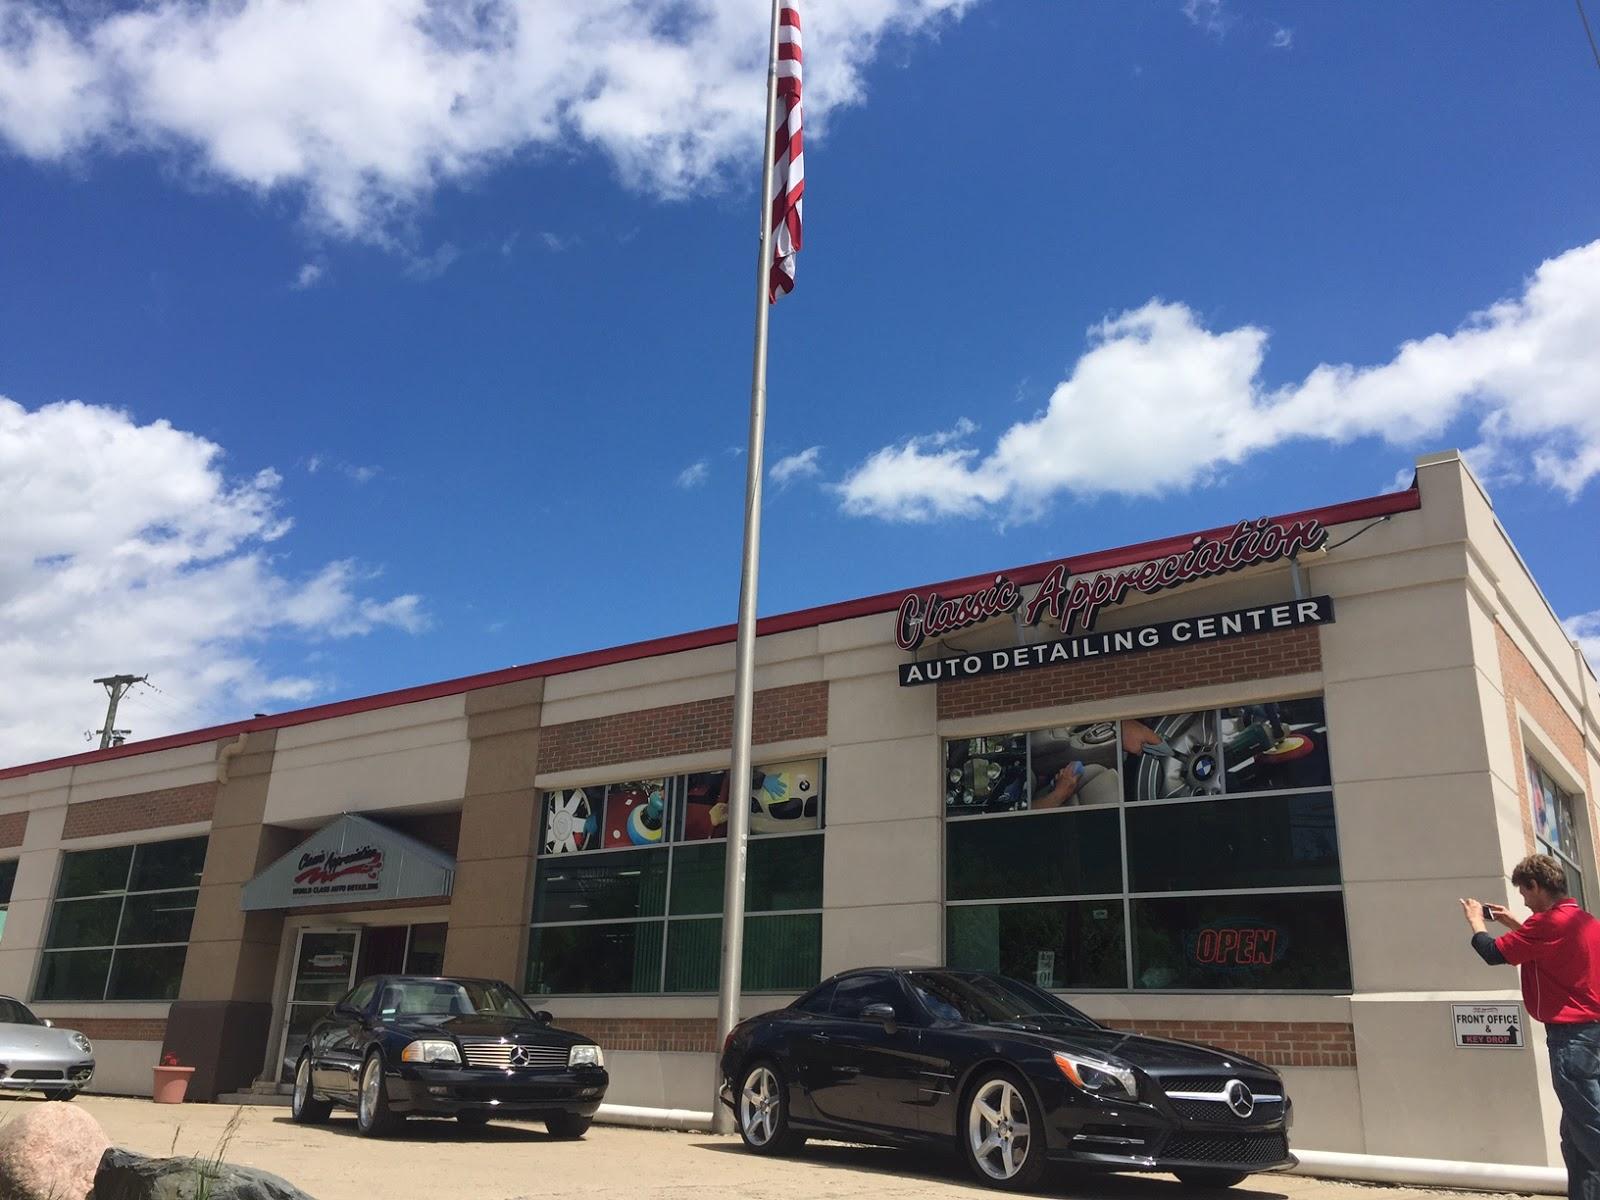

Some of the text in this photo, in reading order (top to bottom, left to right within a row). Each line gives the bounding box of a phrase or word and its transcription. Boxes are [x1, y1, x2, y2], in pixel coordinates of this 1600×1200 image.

[895, 517, 1326, 651] Classic Appreciation
[906, 600, 1322, 684] AUTO DETAILING CENTER
[347, 883, 379, 891] DETAIL
[1197, 929, 1276, 964] OPEN
[1456, 1014, 1518, 1024] FRONT OFFICE
[1485, 1025, 1492, 1033] &
[1466, 1036, 1510, 1044] KEY DROP
